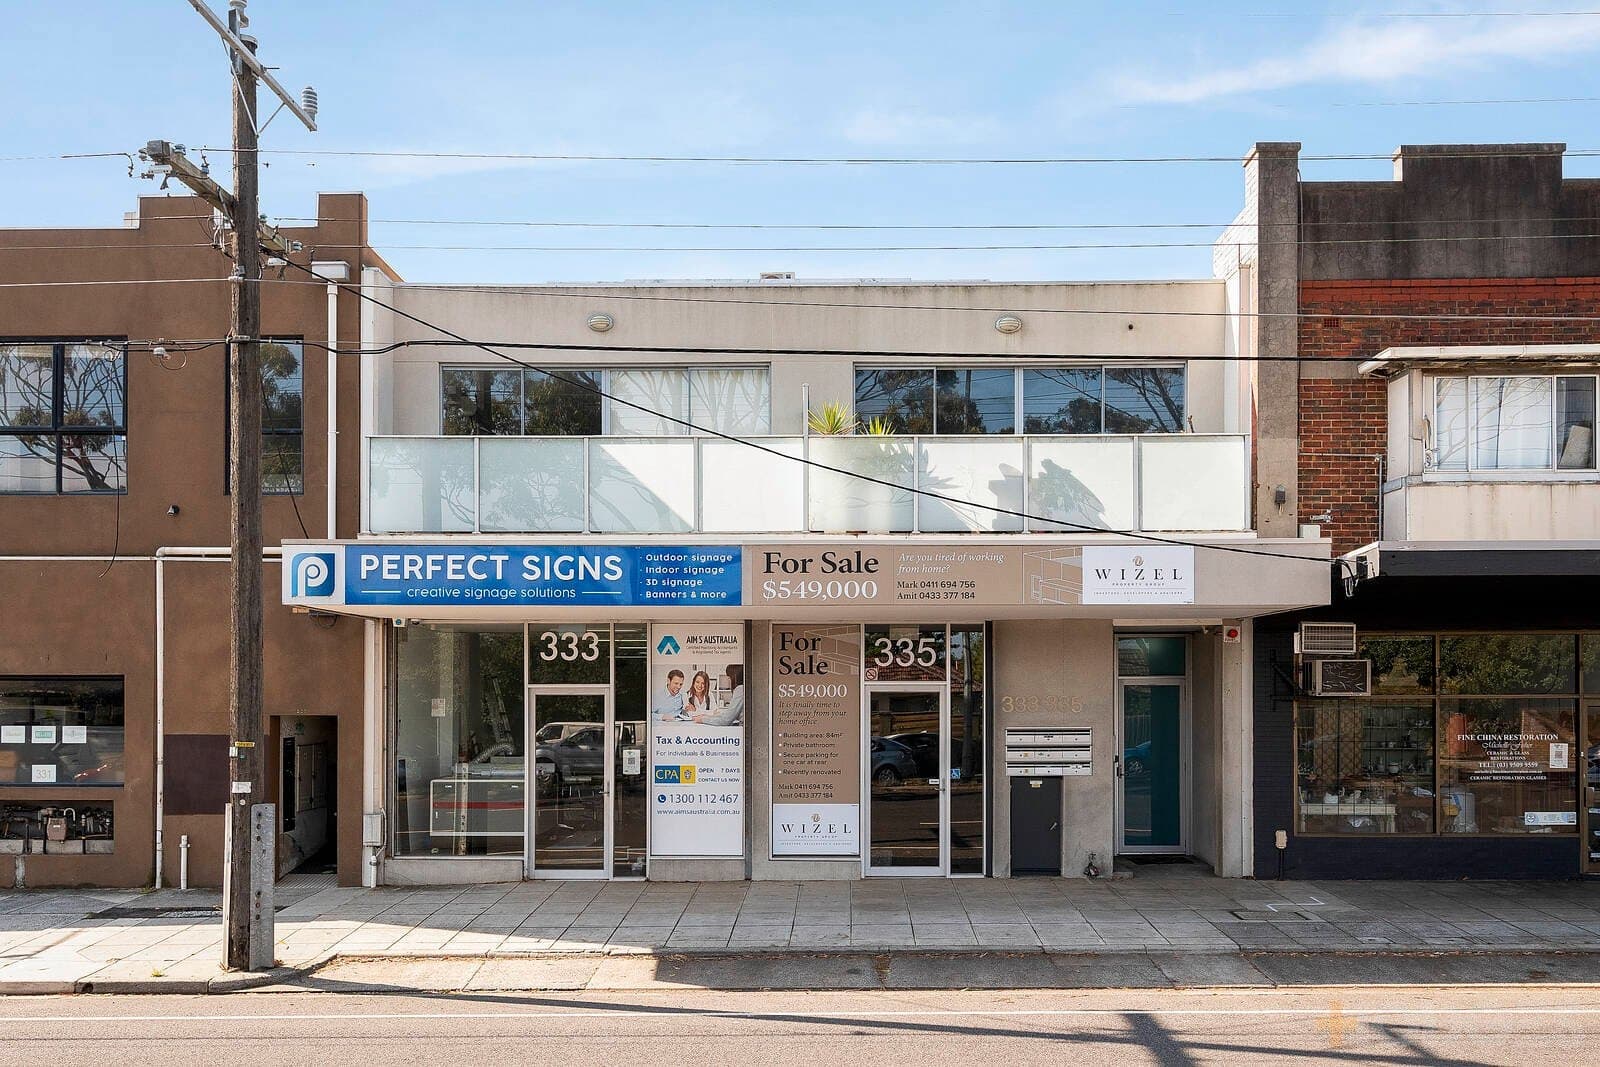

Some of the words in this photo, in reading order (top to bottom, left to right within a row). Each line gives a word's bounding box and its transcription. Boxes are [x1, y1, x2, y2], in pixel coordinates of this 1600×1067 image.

[645, 553, 688, 561] Outdoor
[691, 553, 733, 563] signage
[762, 551, 814, 574] For
[820, 550, 880, 574] Sale
[898, 552, 915, 562] Are
[916, 555, 932, 564] you
[935, 552, 956, 562] tired
[957, 552, 968, 564] of
[968, 552, 1004, 564] working
[360, 554, 509, 581] PERFECT
[521, 555, 623, 581] SIGNS
[645, 566, 680, 574] Indoor
[683, 566, 725, 576] signage
[896, 564, 920, 576] from
[921, 564, 951, 574] home?
[1094, 568, 1183, 580] WIZEL
[645, 578, 658, 586] 3D
[662, 578, 703, 588] signage
[896, 580, 918, 588] Mark
[920, 580, 938, 588] 0411
[940, 580, 957, 588] 694
[960, 580, 976, 588] 756
[406, 587, 461, 598] creative
[464, 587, 517, 600] signage
[520, 587, 576, 598] solutions
[645, 590, 687, 598] Banners
[762, 578, 878, 602] $549,000
[539, 631, 600, 661] 333
[704, 636, 738, 644] AUSTRALIA
[779, 632, 822, 651] For
[874, 638, 937, 667] 335
[778, 655, 828, 675] Sale
[778, 684, 848, 698] $549,000
[779, 710, 792, 718] step
[812, 710, 830, 718] from
[656, 736, 672, 744] Tax
[675, 736, 682, 744] &
[685, 736, 740, 746] Accounting
[656, 770, 679, 780] CPA
[669, 794, 695, 804] 1300
[698, 794, 717, 804] 112
[719, 794, 739, 804] 467
[781, 823, 852, 834] WIZEL
